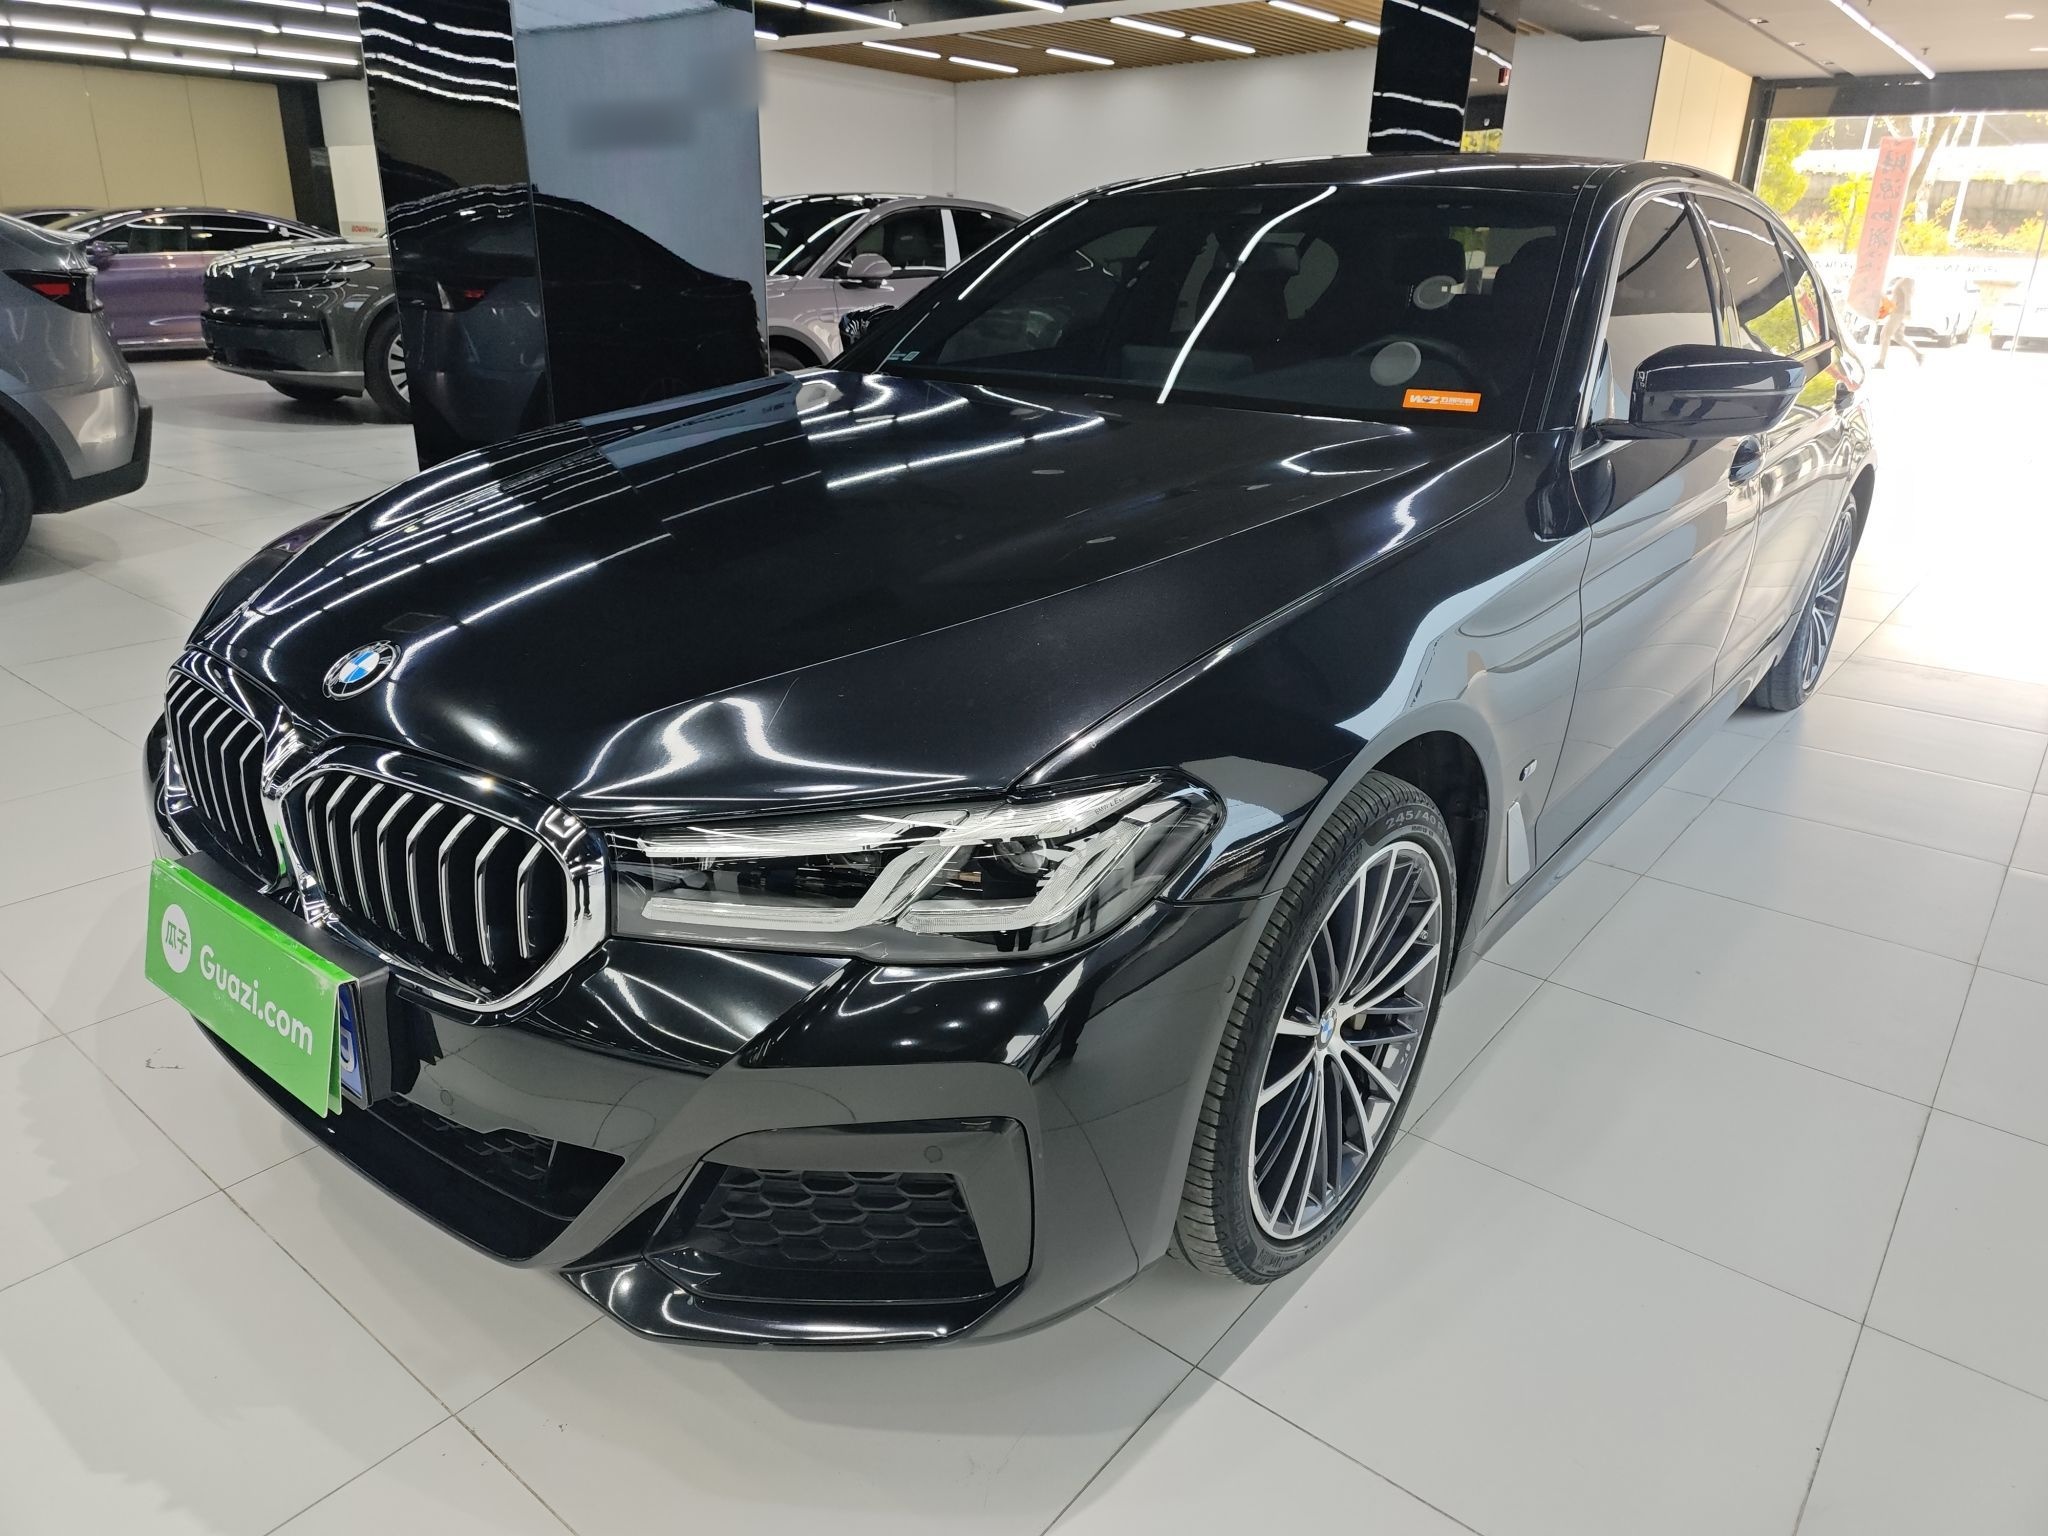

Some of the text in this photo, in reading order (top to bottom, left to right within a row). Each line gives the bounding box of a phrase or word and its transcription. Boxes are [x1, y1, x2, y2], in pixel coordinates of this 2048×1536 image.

[1385, 809, 1436, 829] 245/40
[166, 920, 188, 955] 瓜子
[199, 944, 313, 1055] Guazi.com
